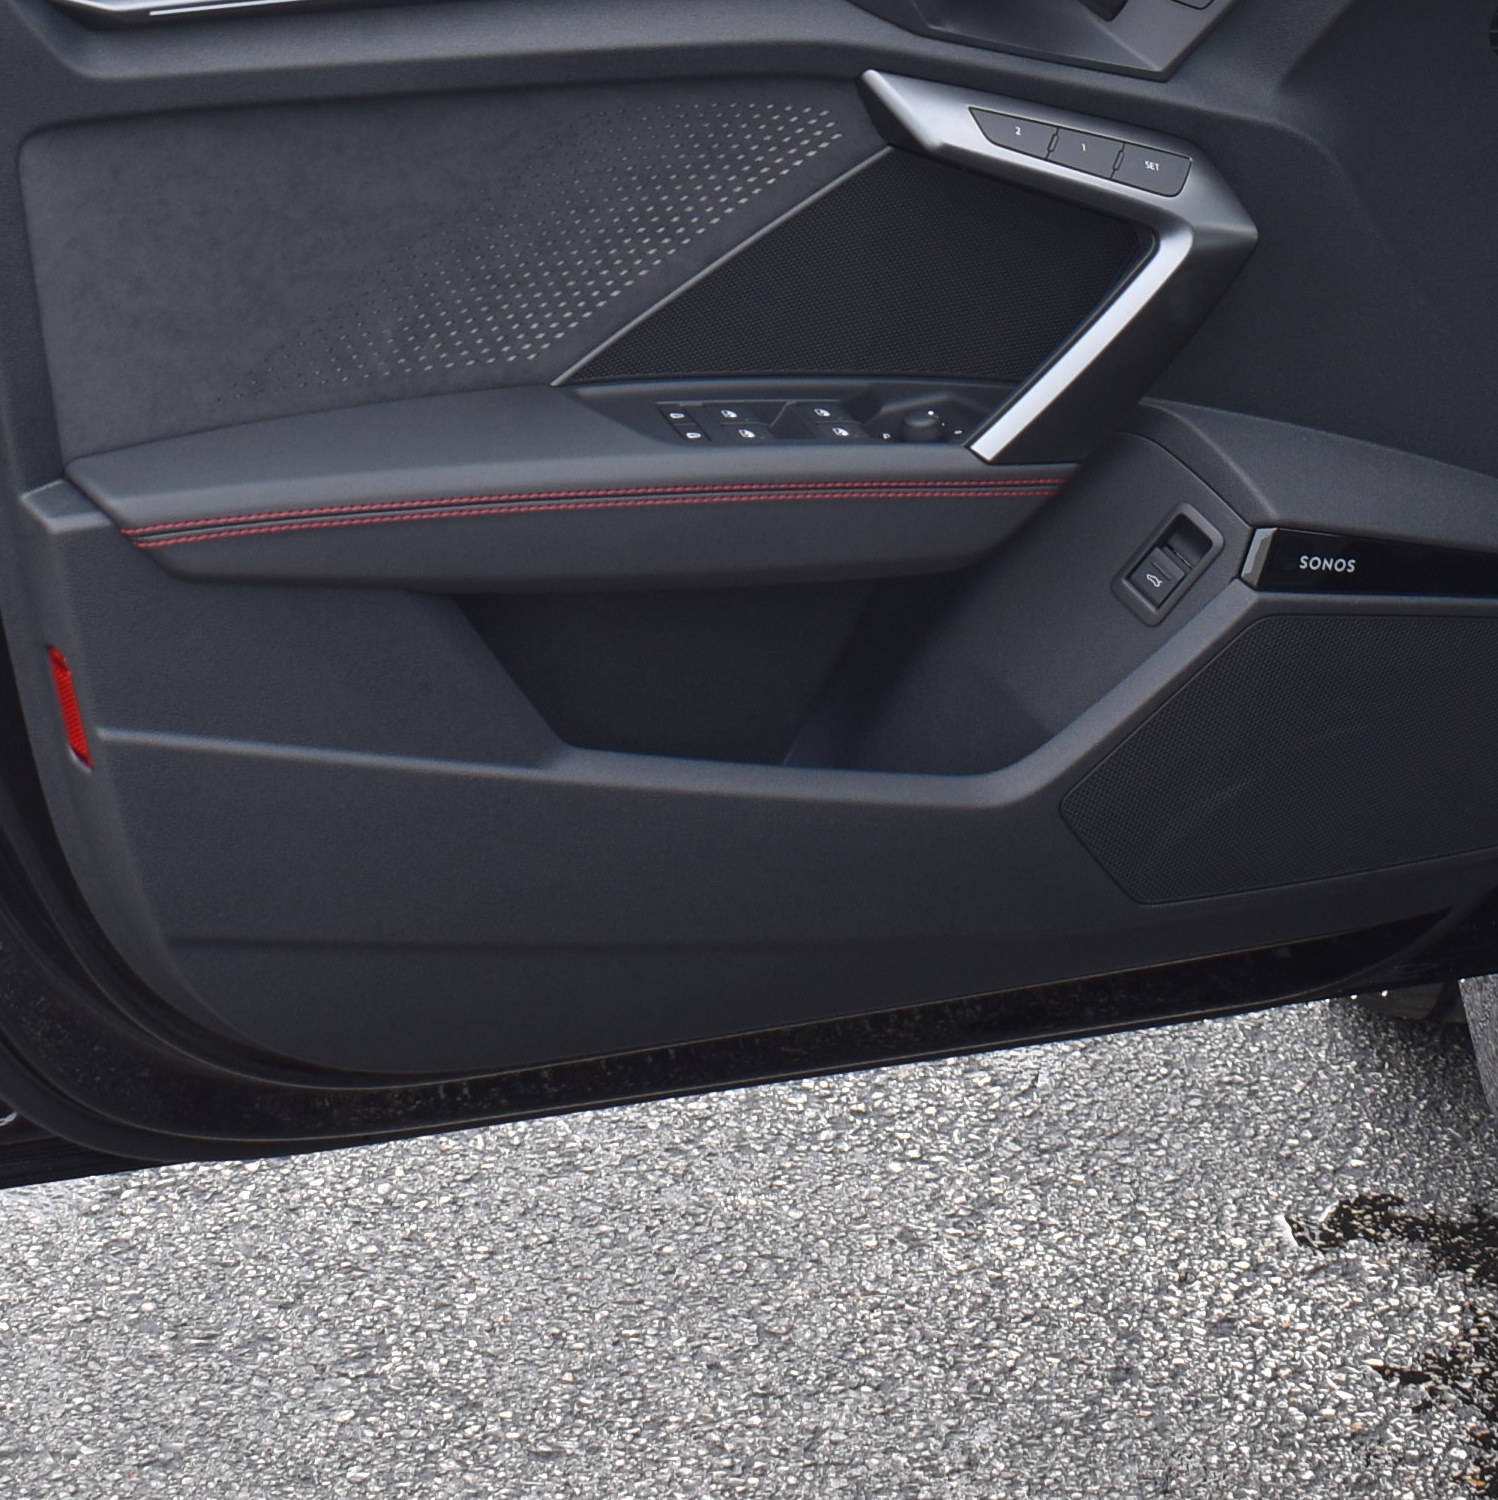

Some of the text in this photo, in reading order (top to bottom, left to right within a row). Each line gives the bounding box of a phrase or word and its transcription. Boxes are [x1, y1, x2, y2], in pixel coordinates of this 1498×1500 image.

[1015, 126, 1022, 136] 2
[1081, 143, 1086, 152] 1
[1144, 160, 1160, 172] SET
[1299, 555, 1357, 573] SONOS
